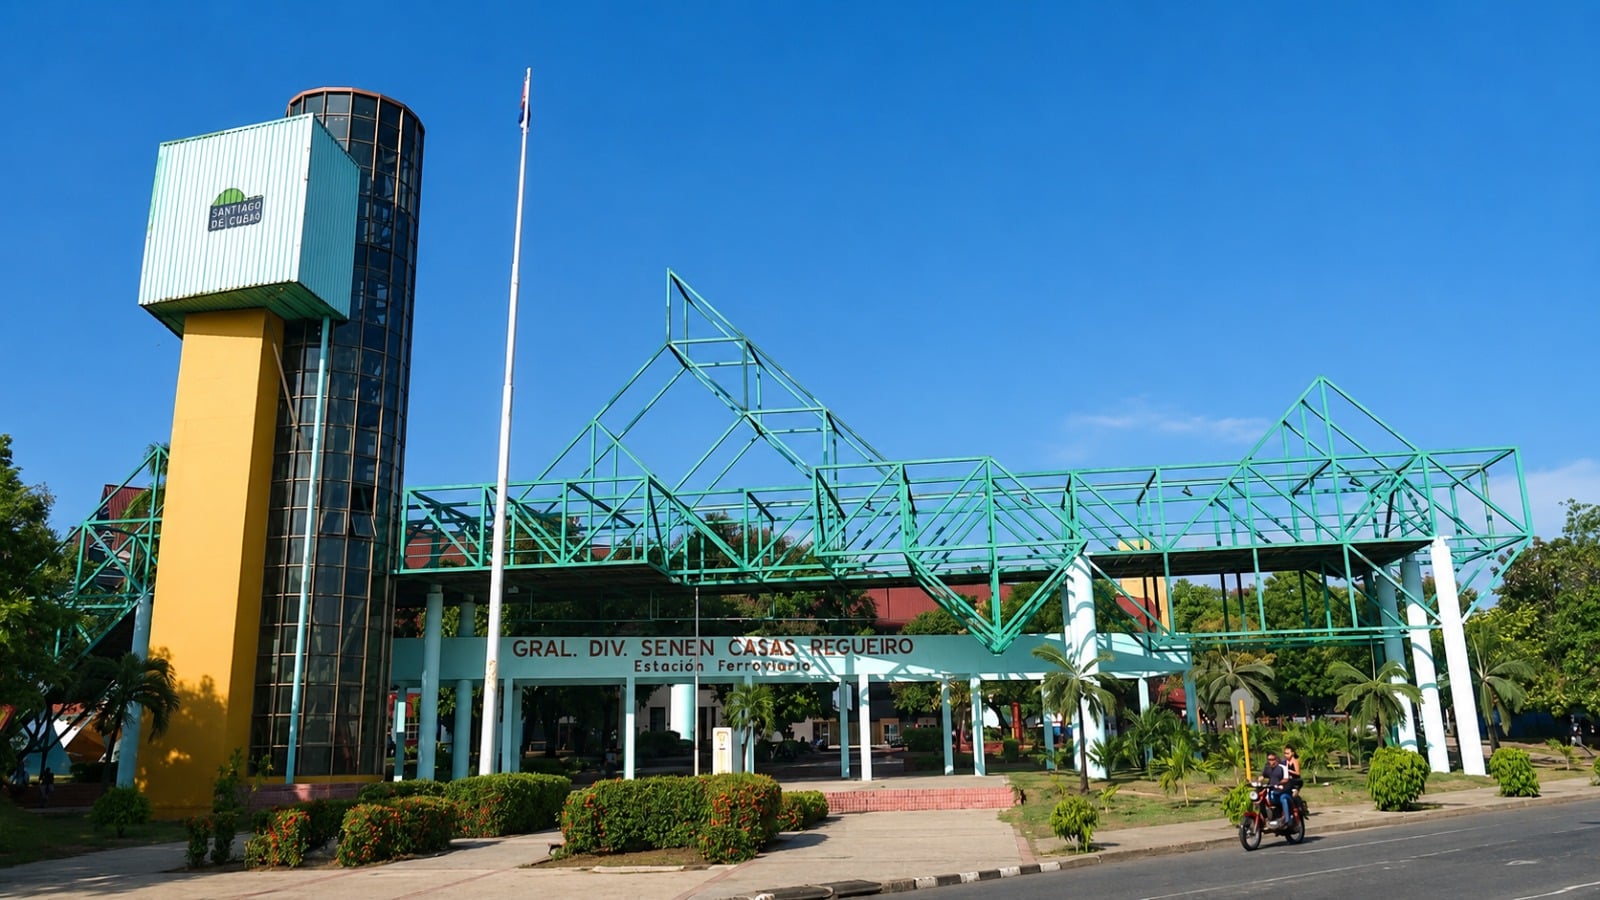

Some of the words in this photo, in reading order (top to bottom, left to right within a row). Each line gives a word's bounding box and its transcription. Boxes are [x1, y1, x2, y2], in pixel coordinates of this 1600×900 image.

[212, 201, 261, 218] SANTIAGO
[211, 218, 225, 229] DE
[512, 639, 577, 657] GRAL.
[589, 639, 627, 657] DIV.
[641, 639, 714, 657] SENEN
[728, 638, 796, 656] CASAS
[810, 637, 914, 656] REGUEIRO
[634, 658, 704, 672] Estación
[718, 659, 811, 672] Ferroviario
